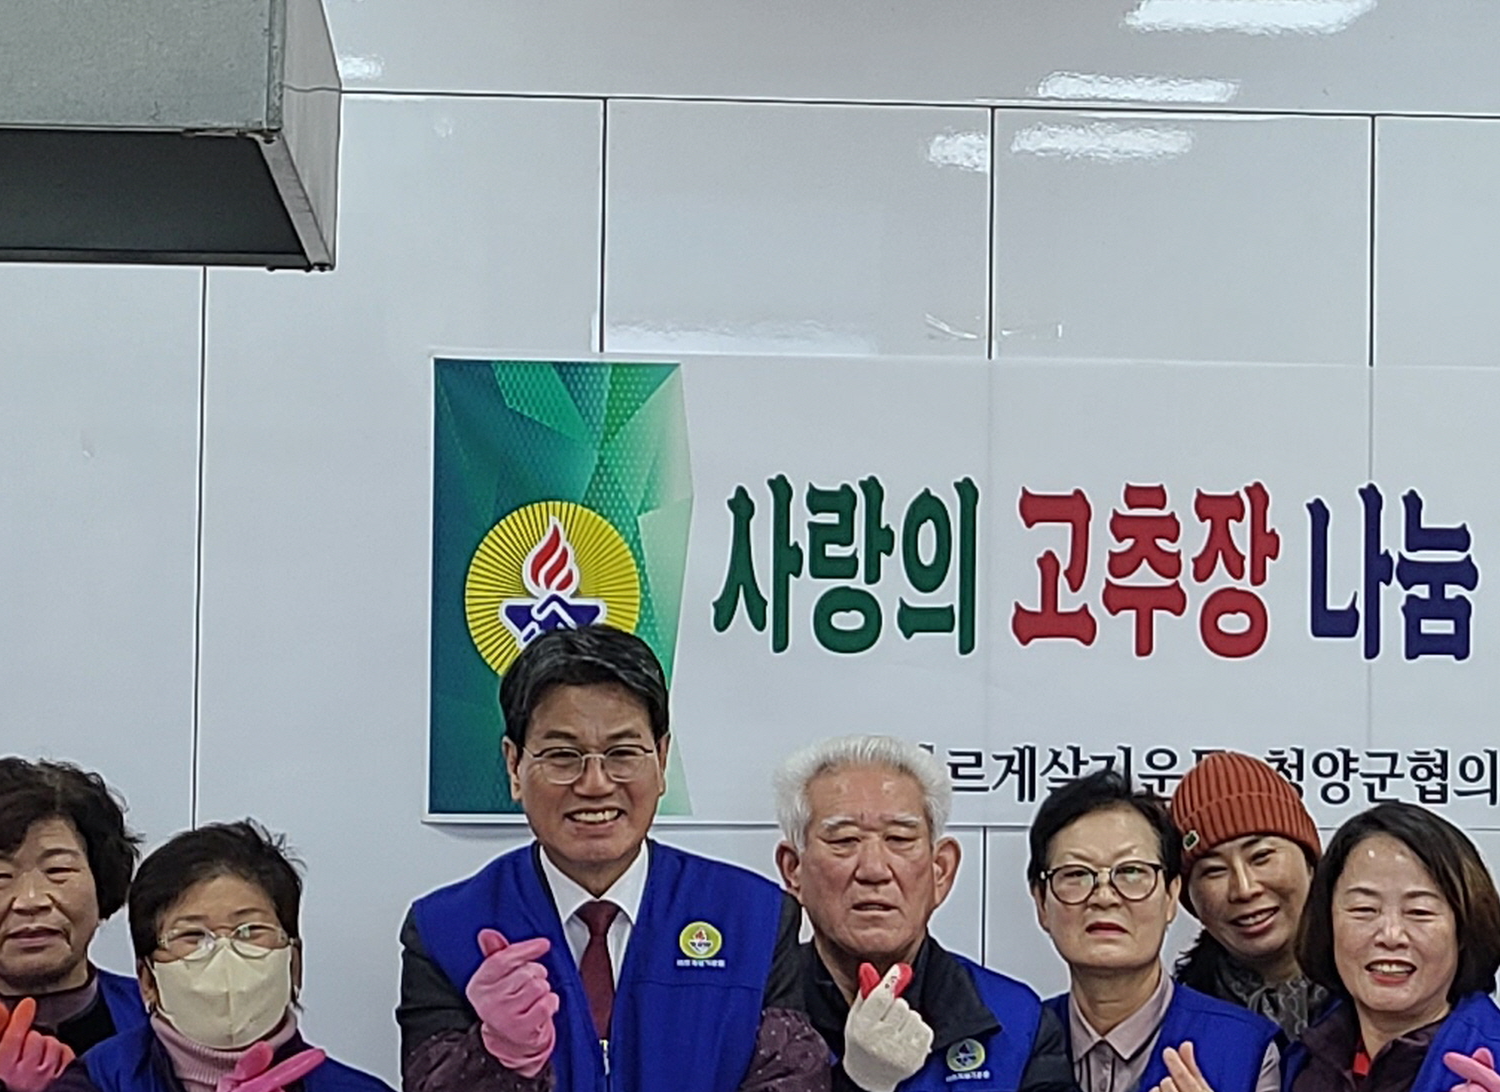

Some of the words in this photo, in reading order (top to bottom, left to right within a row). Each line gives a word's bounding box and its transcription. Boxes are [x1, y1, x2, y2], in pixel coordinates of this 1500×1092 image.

[712, 473, 980, 655] 사랑의
[1011, 481, 1280, 659] 고추장
[1305, 483, 1480, 661] 나눔
[918, 743, 1228, 803] 르게살기운
